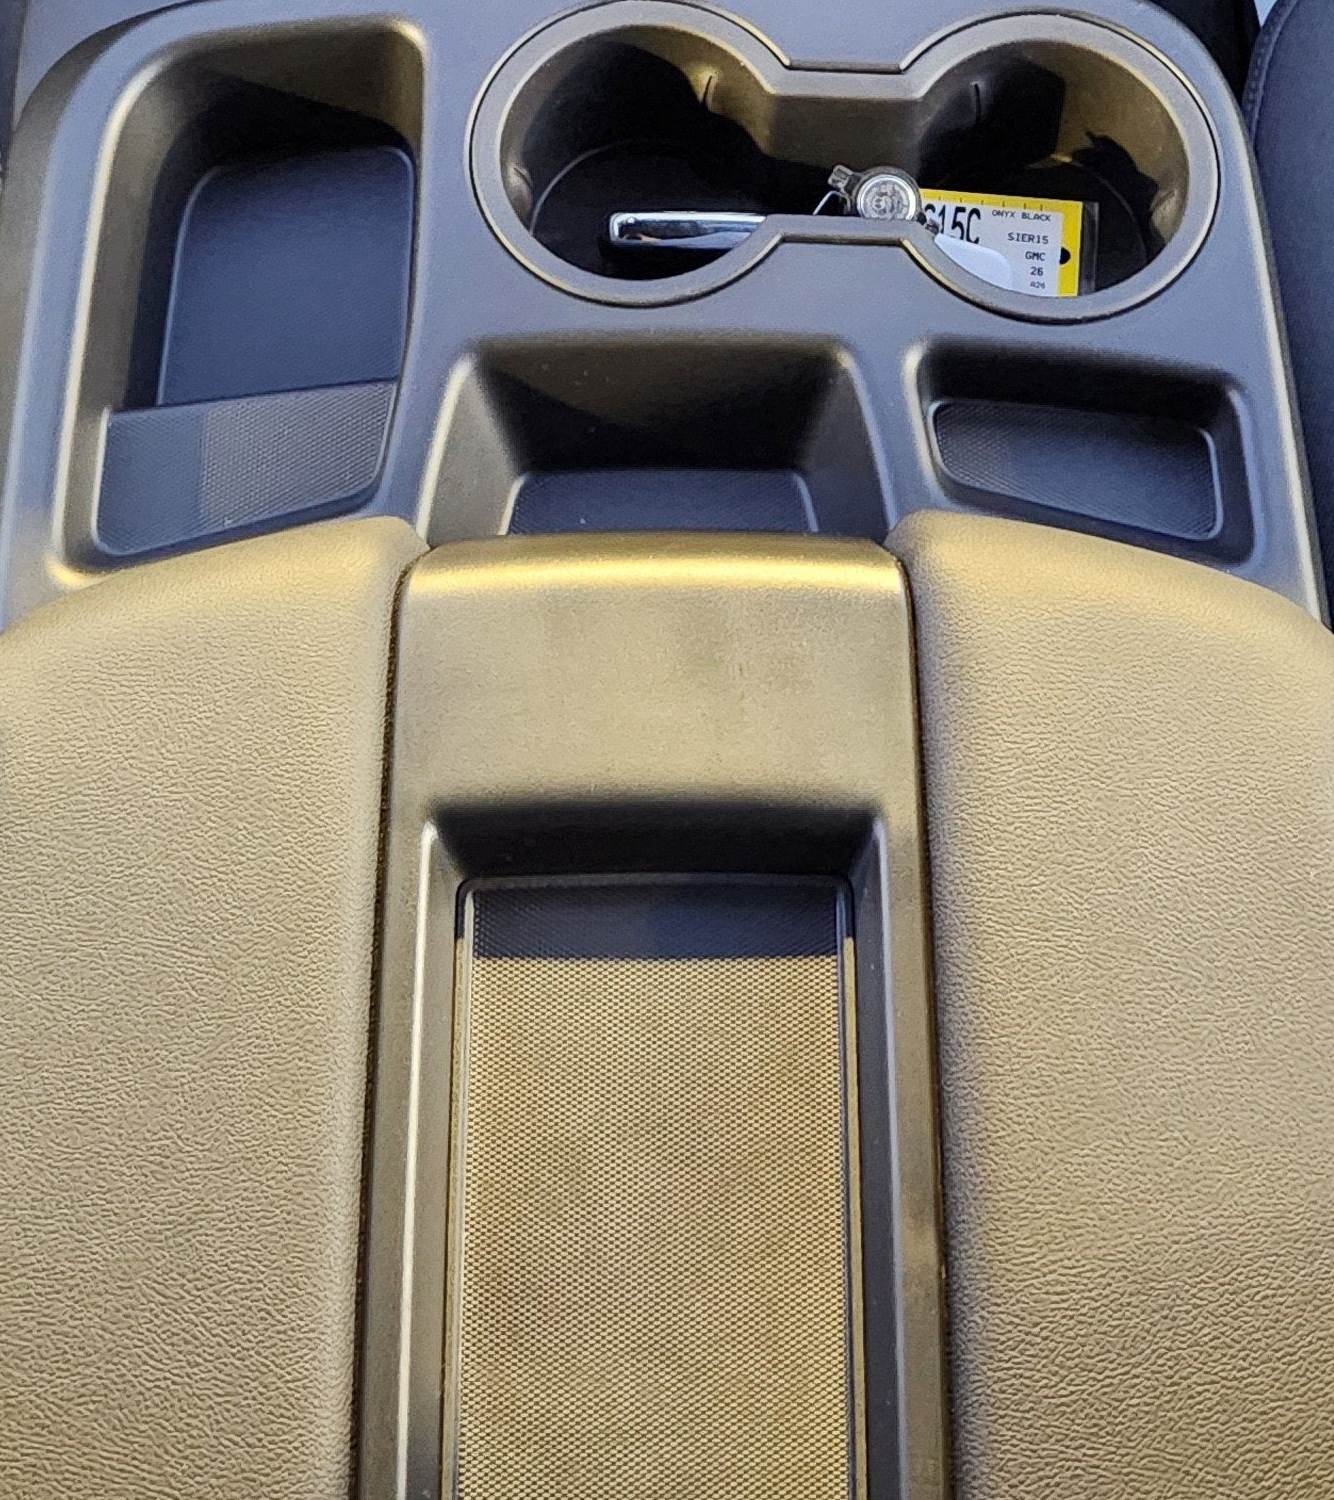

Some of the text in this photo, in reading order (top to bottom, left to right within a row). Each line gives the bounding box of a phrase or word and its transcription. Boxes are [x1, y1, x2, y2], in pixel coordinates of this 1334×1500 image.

[992, 209, 1051, 222] ONYX BLACK
[1007, 232, 1049, 244] SIER15
[1025, 251, 1046, 262] GMC
[1030, 266, 1044, 276] 26
